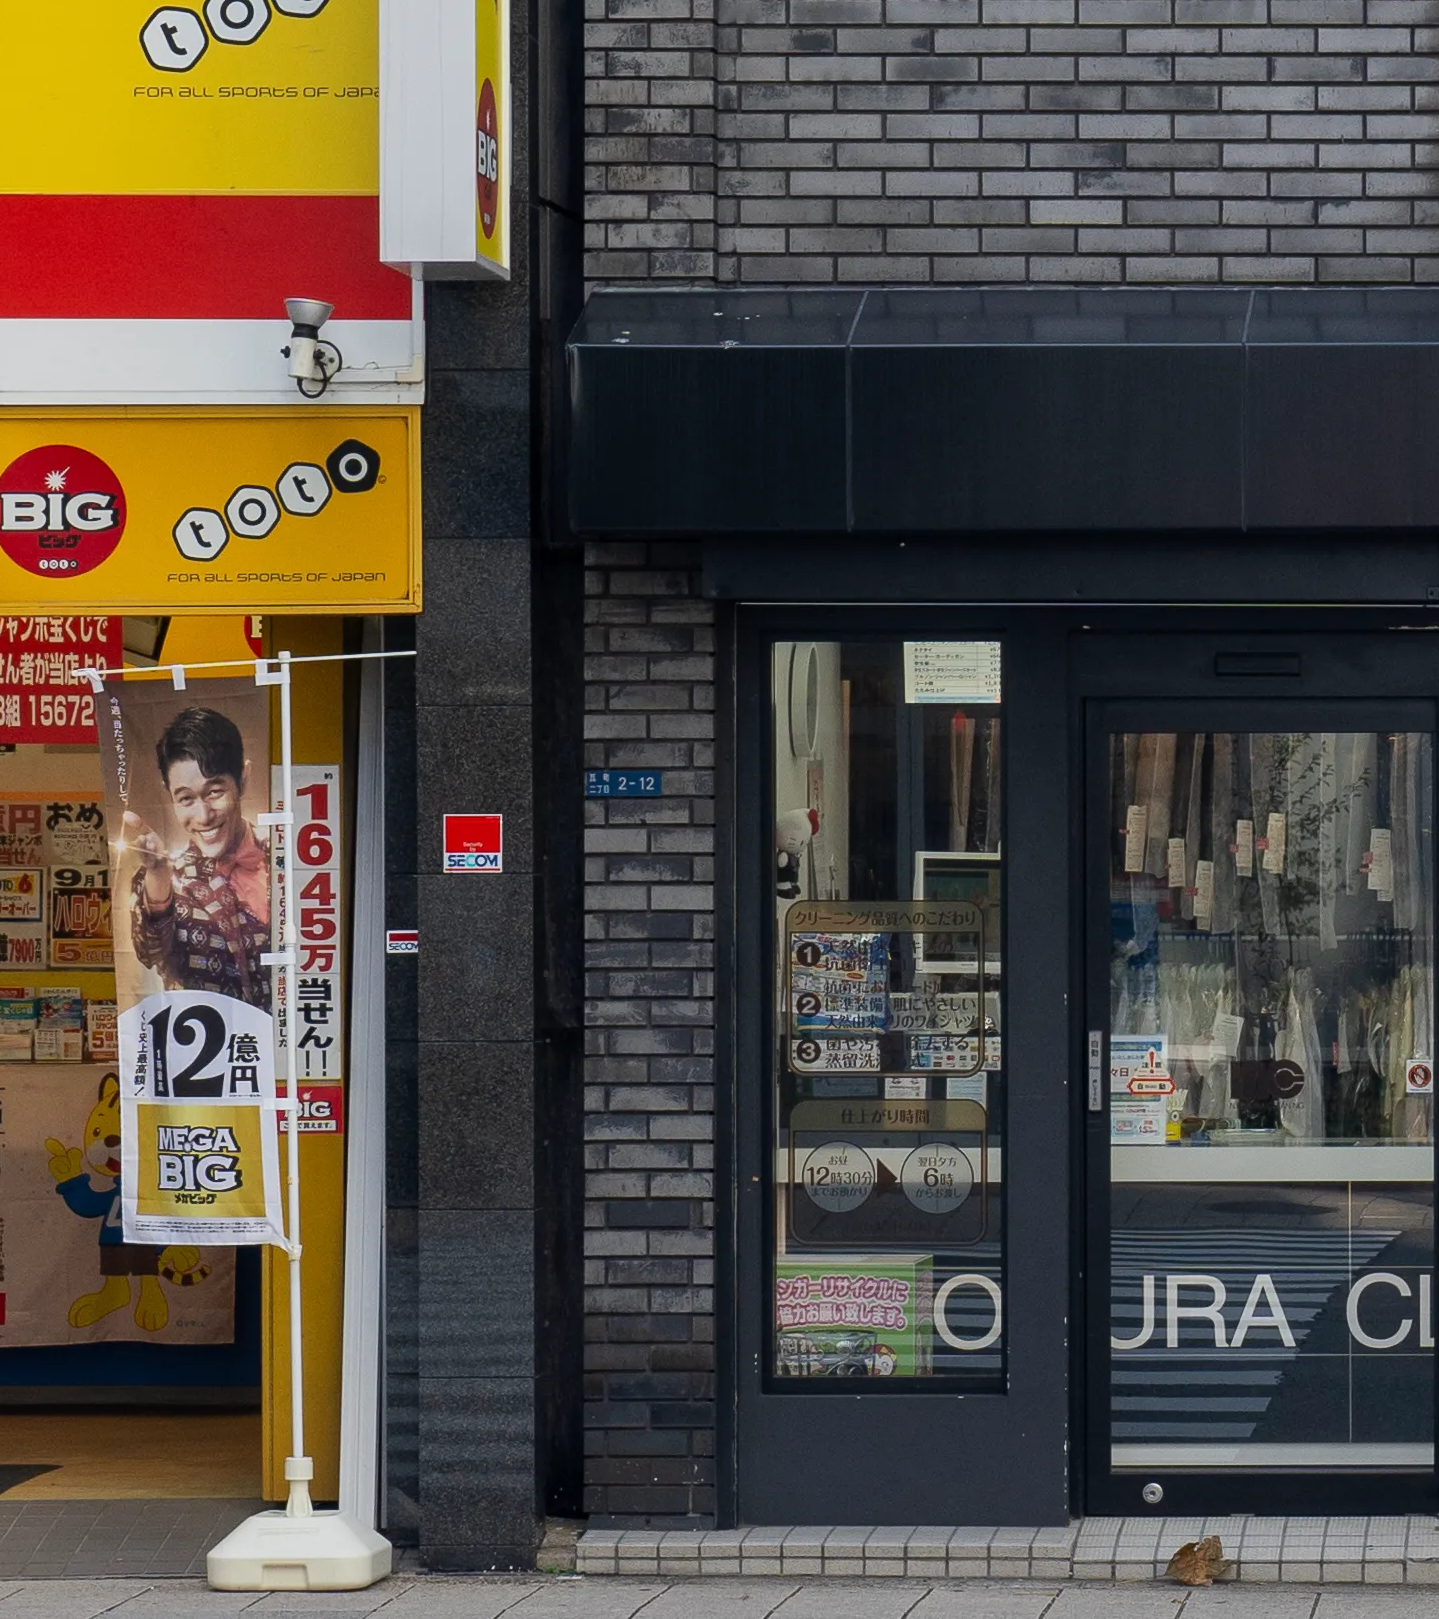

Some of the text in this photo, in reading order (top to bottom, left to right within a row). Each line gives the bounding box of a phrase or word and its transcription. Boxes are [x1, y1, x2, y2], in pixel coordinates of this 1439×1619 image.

[133, 86, 174, 98] FOR
[303, 86, 329, 98] OF
[476, 130, 499, 183] BIG
[179, 445, 376, 555] toto
[0, 490, 119, 534] BIG
[38, 534, 82, 549] ビッグ
[38, 559, 79, 570] toto
[167, 572, 200, 583] FOR
[305, 572, 328, 583] OF
[618, 777, 656, 791] 2-12
[447, 854, 498, 868] SECOM
[794, 911, 976, 927] クリーニング品質へのこだわり
[389, 942, 418, 951] SECOM
[893, 995, 976, 1013] 肌にやさしい
[841, 1109, 930, 1125] 仕上がり時間
[157, 1125, 241, 1152] MEGA
[828, 1155, 849, 1166] お昼
[917, 1157, 957, 1167] 翌日夕方
[157, 1154, 243, 1192] BIG
[806, 1167, 873, 1187] 12時30分
[924, 1167, 954, 1188] 6時
[174, 1193, 217, 1205] メガビッグ
[811, 1187, 868, 1198] までお預かり
[915, 1187, 963, 1199] からお渡し
